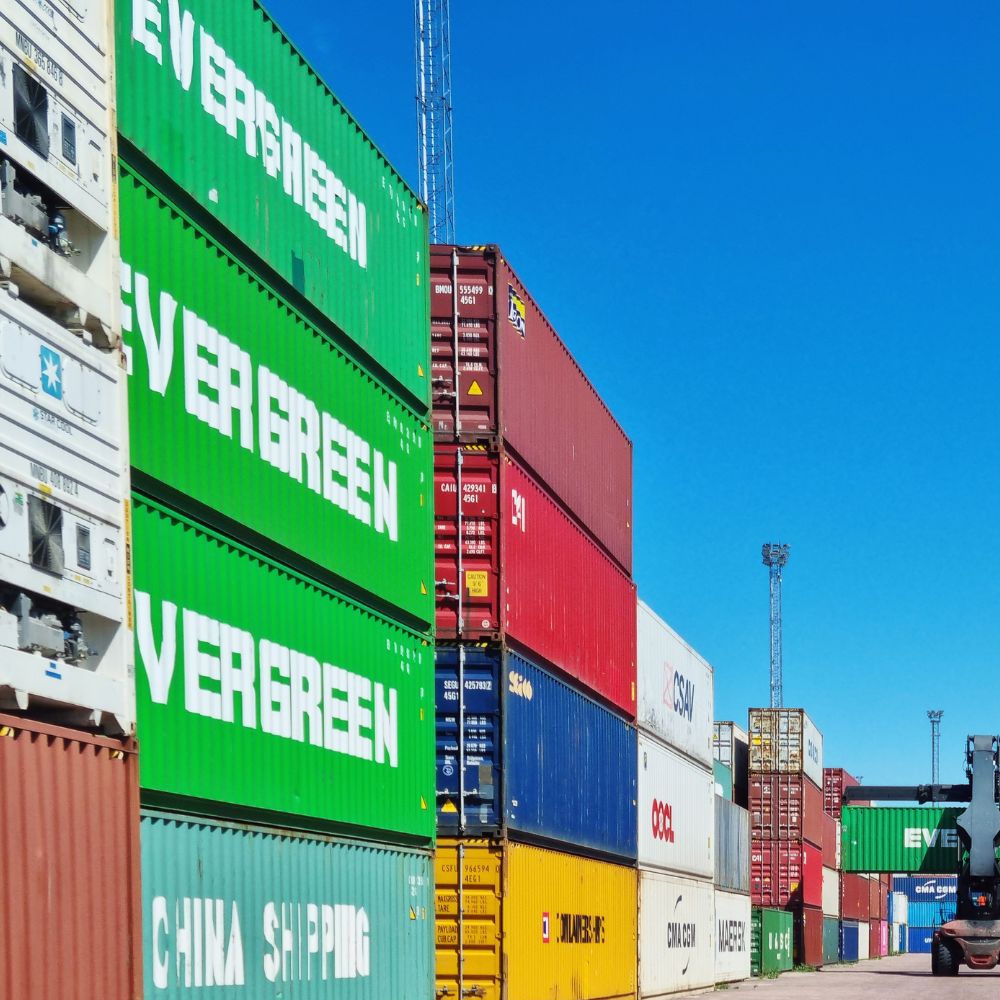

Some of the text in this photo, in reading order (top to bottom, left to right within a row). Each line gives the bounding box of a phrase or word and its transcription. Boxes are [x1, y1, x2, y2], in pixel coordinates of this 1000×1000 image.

[435, 284, 453, 294] BMOU
[459, 285, 483, 295] 555499
[460, 295, 476, 305] 45G1
[441, 483, 457, 493] CAIU
[463, 484, 486, 493] 429341
[463, 494, 479, 503] 45G1
[134, 588, 399, 768] VERGREEN
[443, 680, 459, 690] SEGU
[464, 680, 485, 690] 425793
[443, 691, 459, 701] 45G1
[673, 669, 695, 722] CSAV
[652, 798, 675, 843] OOCL
[915, 886, 957, 894] CMA CGM
[667, 922, 696, 949] CMA CGM
[718, 919, 746, 952] MAERSK
[152, 895, 370, 989] CHINA SHIPPING
